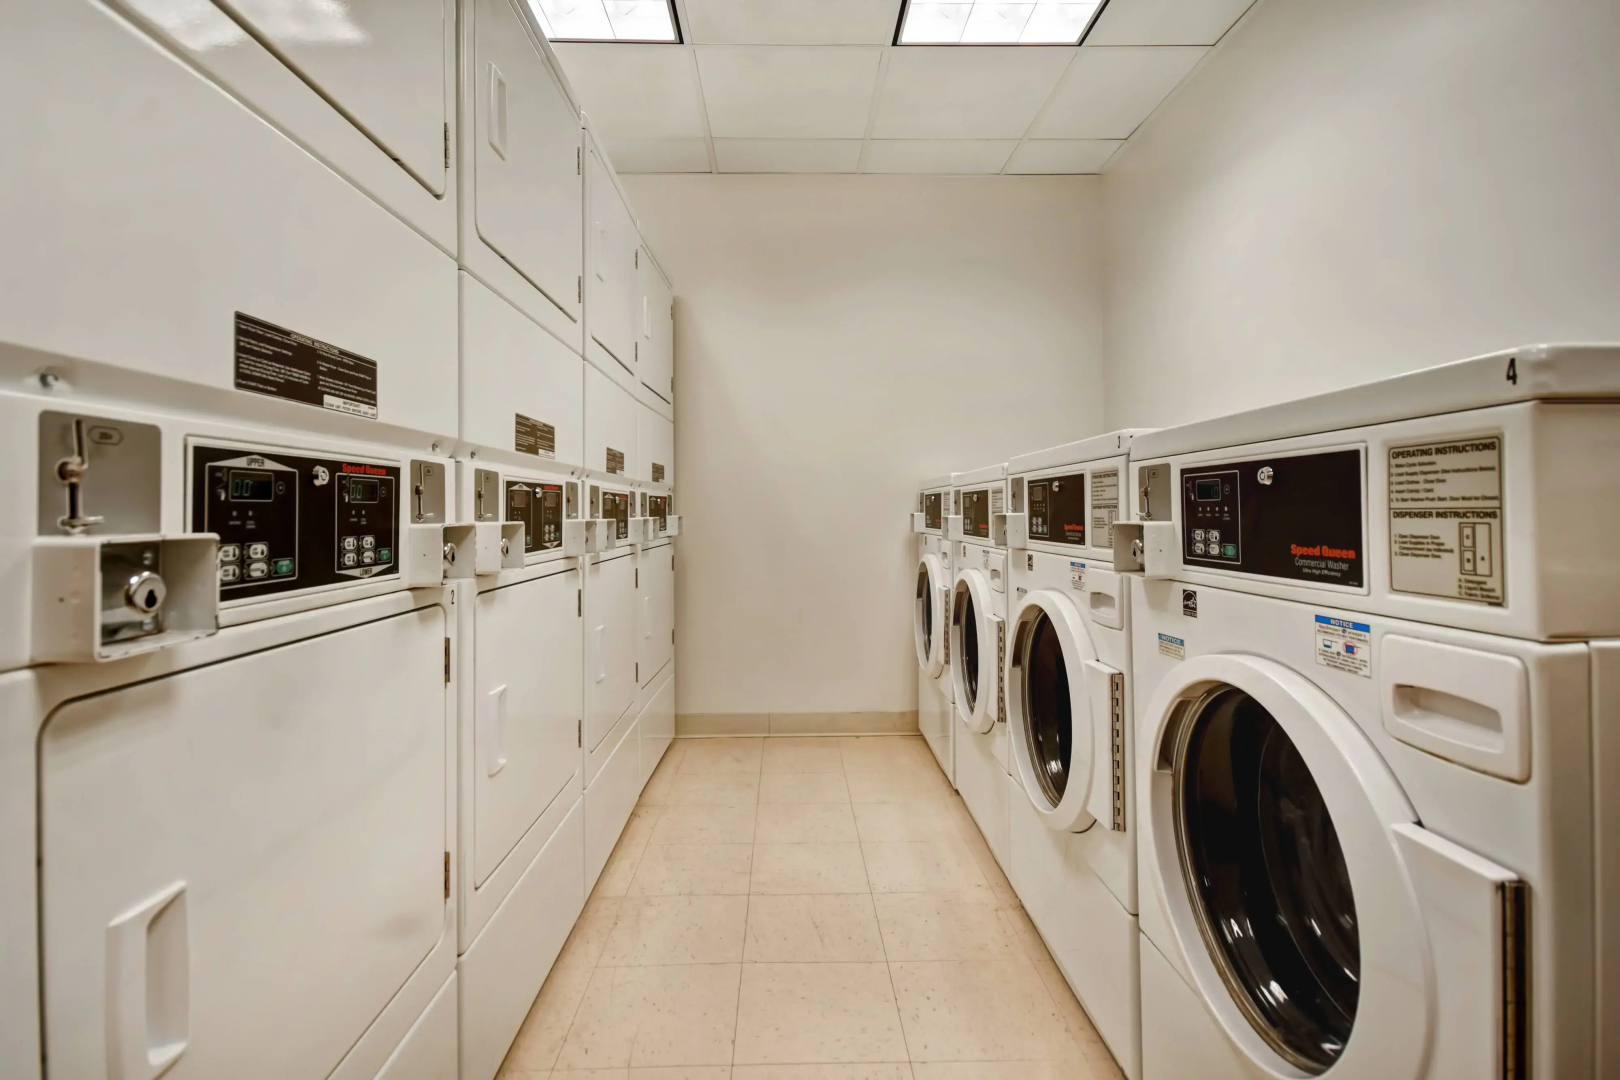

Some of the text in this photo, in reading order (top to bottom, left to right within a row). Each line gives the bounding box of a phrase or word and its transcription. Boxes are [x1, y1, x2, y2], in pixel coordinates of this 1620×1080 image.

[1507, 358, 1517, 385] 4
[1392, 441, 1496, 459] OPERATING INSTRUCTIONS
[246, 458, 265, 467] UPPER
[342, 463, 386, 475] Speed Queen
[1436, 511, 1498, 519] INSTRUCTIONS
[1291, 544, 1356, 559] Speed Queen
[1295, 557, 1349, 570] Commercial Washer
[360, 568, 372, 576] LOWER
[451, 590, 454, 604] 2
[1331, 619, 1353, 628] NOTICE
[1162, 634, 1181, 644] NOTICE
